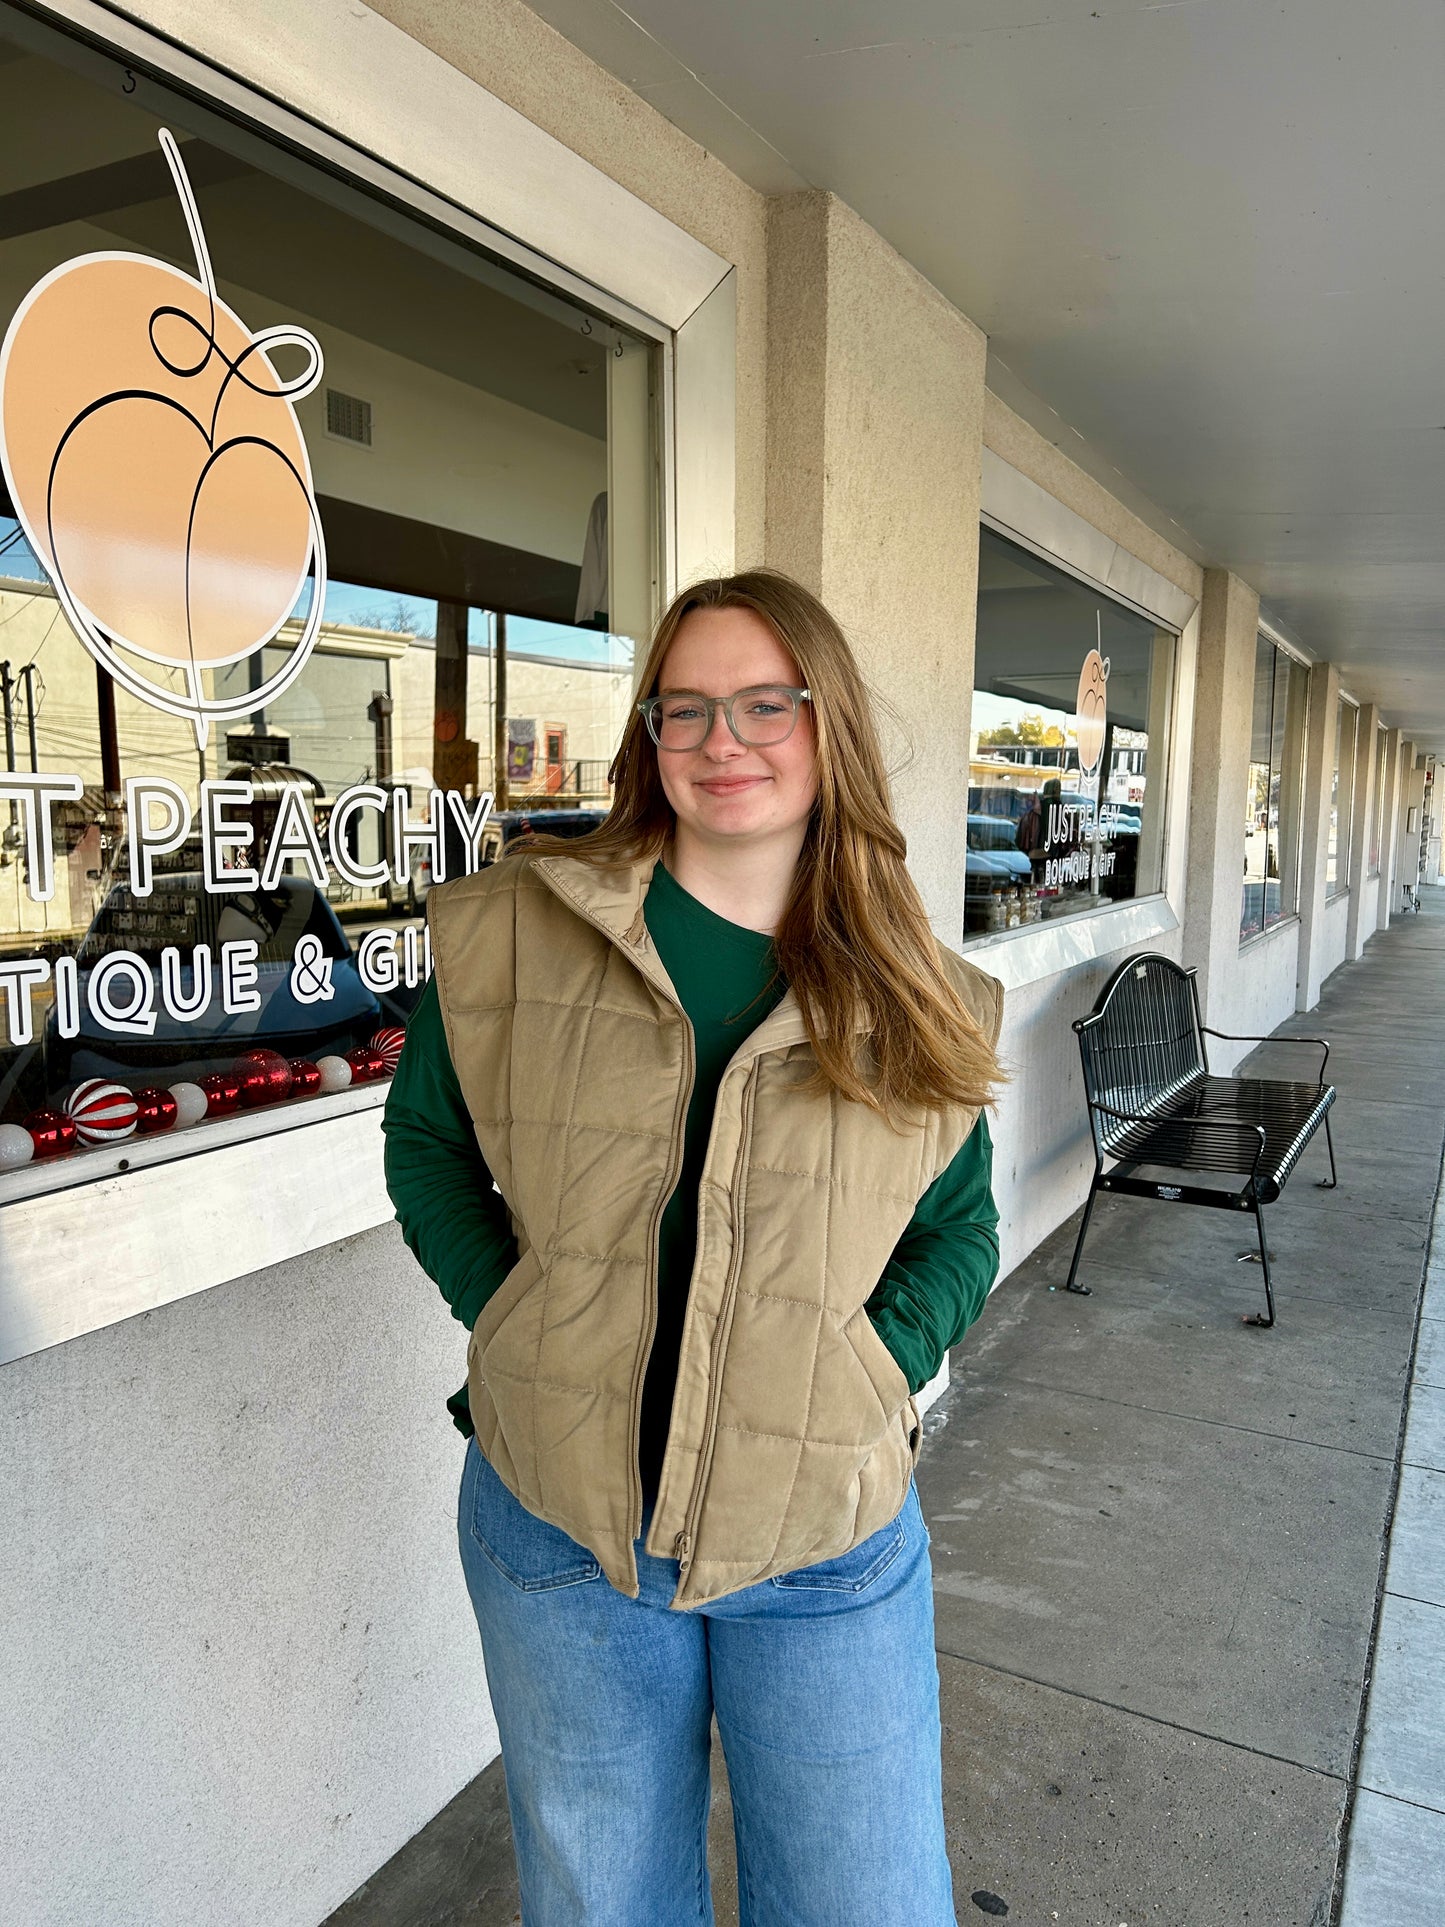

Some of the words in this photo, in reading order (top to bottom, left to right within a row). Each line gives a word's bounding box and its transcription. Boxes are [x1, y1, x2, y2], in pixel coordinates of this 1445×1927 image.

[125, 776, 494, 898] PEACHY
[1044, 804, 1077, 852] JUST
[1078, 804, 1120, 842] PEACHY
[1045, 855, 1090, 886] BOUTIQUE
[1100, 852, 1116, 877] GIFT
[0, 940, 261, 1046] TIQUE
[291, 934, 334, 1004] &
